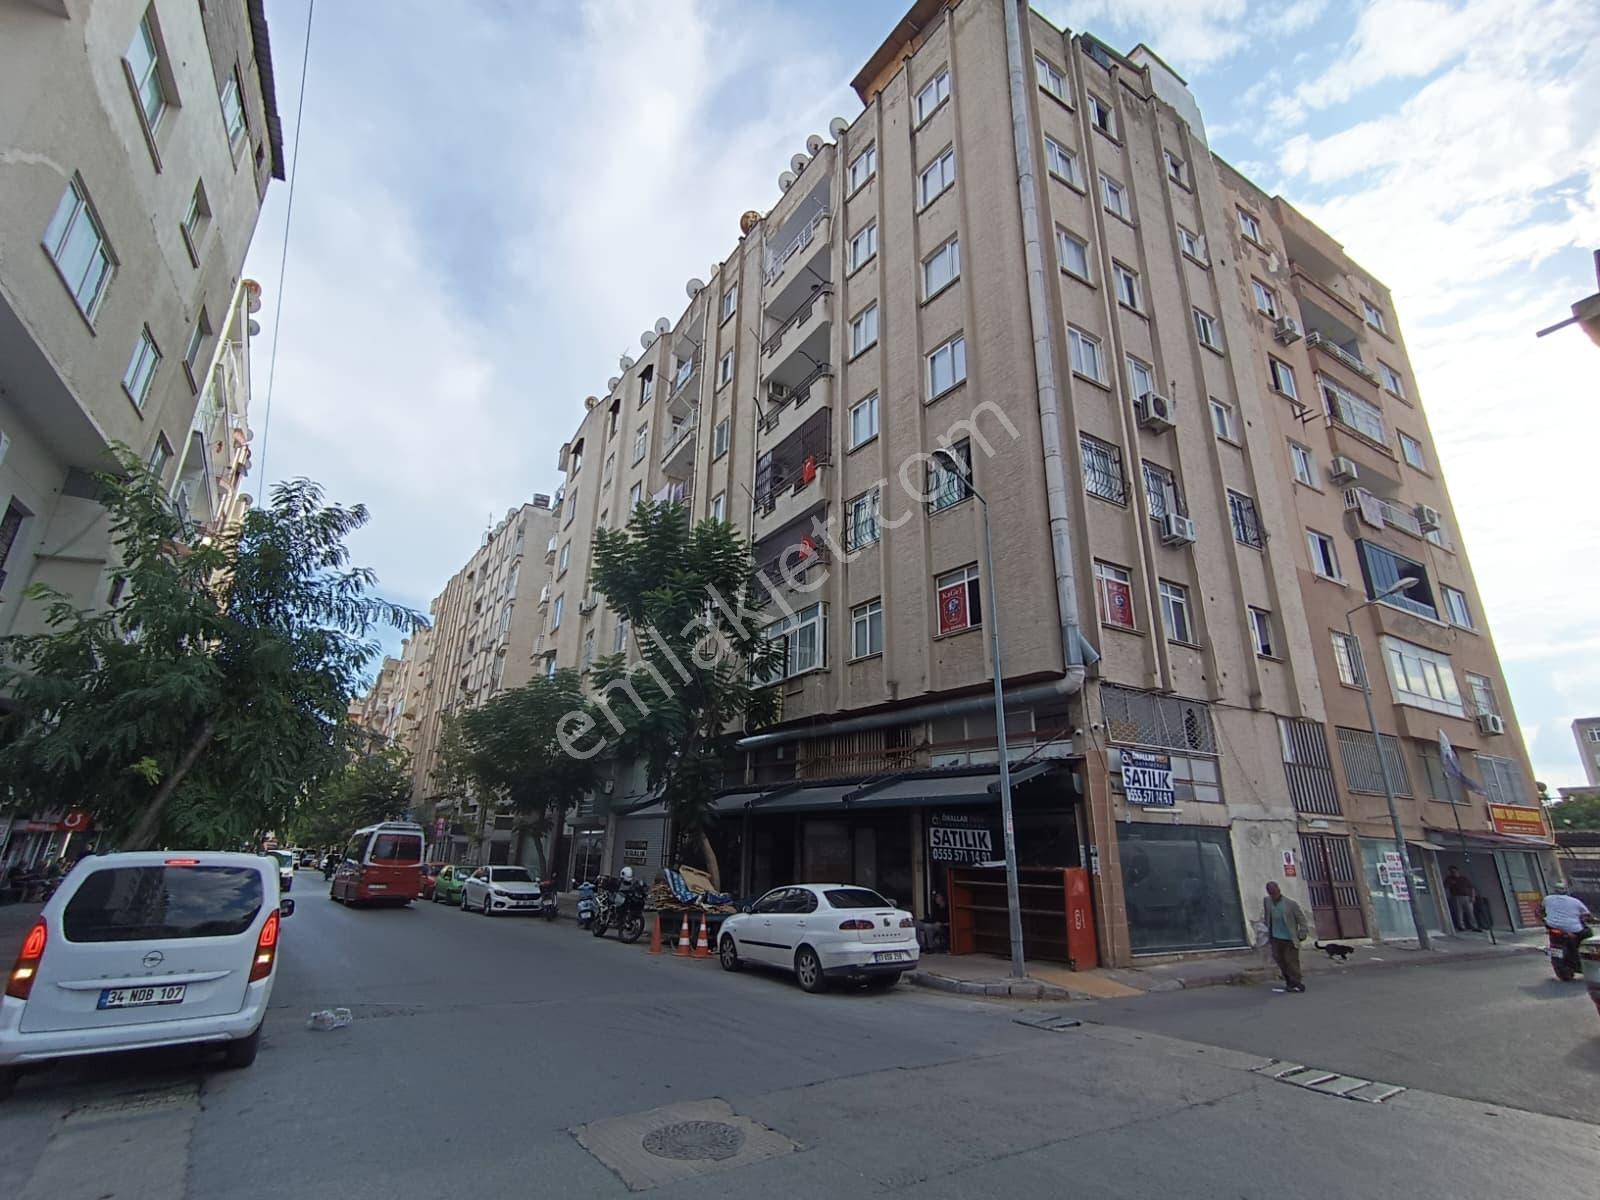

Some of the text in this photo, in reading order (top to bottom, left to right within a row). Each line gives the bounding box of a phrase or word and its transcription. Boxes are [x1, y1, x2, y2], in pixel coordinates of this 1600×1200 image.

[1124, 768, 1170, 789] SATILIK
[1126, 789, 1143, 802] 0555
[1143, 790, 1154, 803] 571
[933, 829, 988, 848] SATILIK
[933, 848, 952, 860] 0555
[953, 849, 968, 862] 571
[108, 987, 183, 1003] 34 NDB 107
